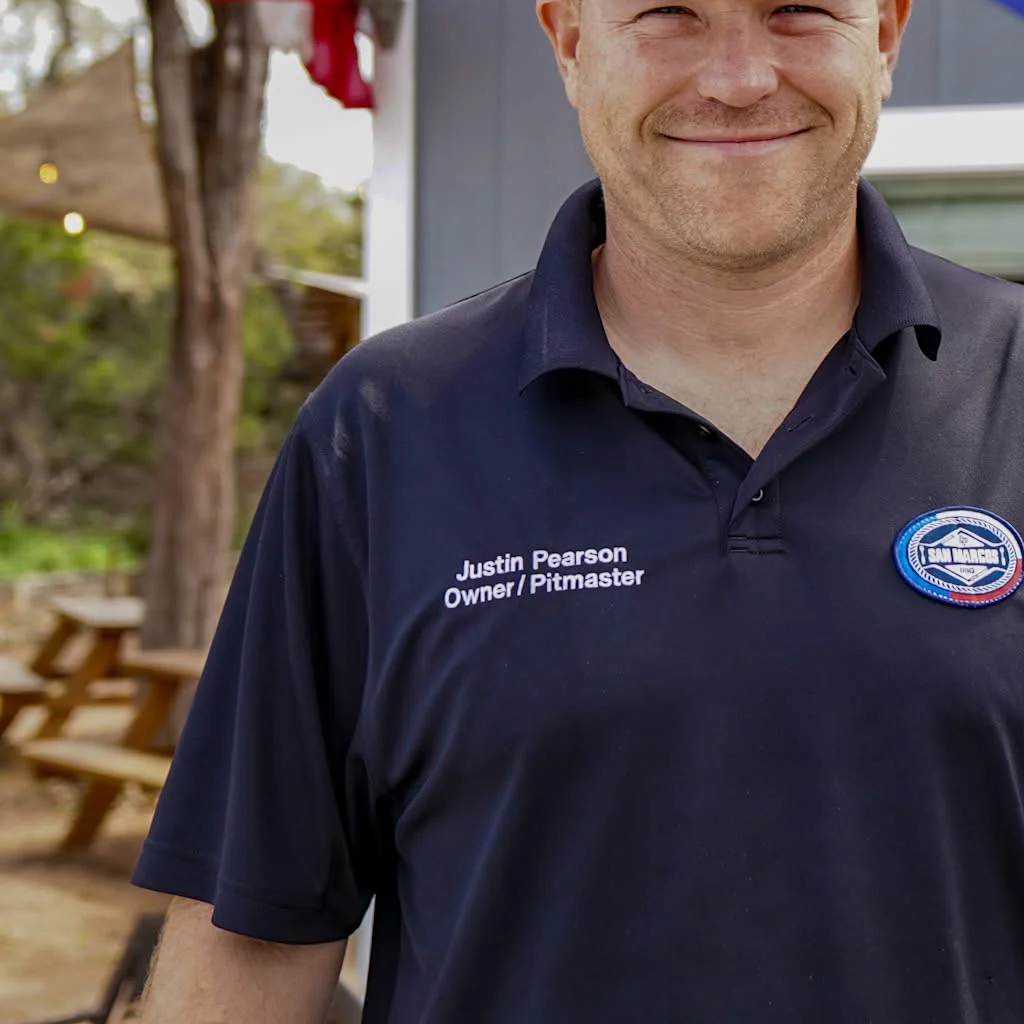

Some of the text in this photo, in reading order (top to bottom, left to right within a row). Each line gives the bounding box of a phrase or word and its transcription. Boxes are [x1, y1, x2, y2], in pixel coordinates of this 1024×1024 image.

[456, 546, 628, 582] Justin Pearson
[928, 548, 999, 564] SAN MARCOS
